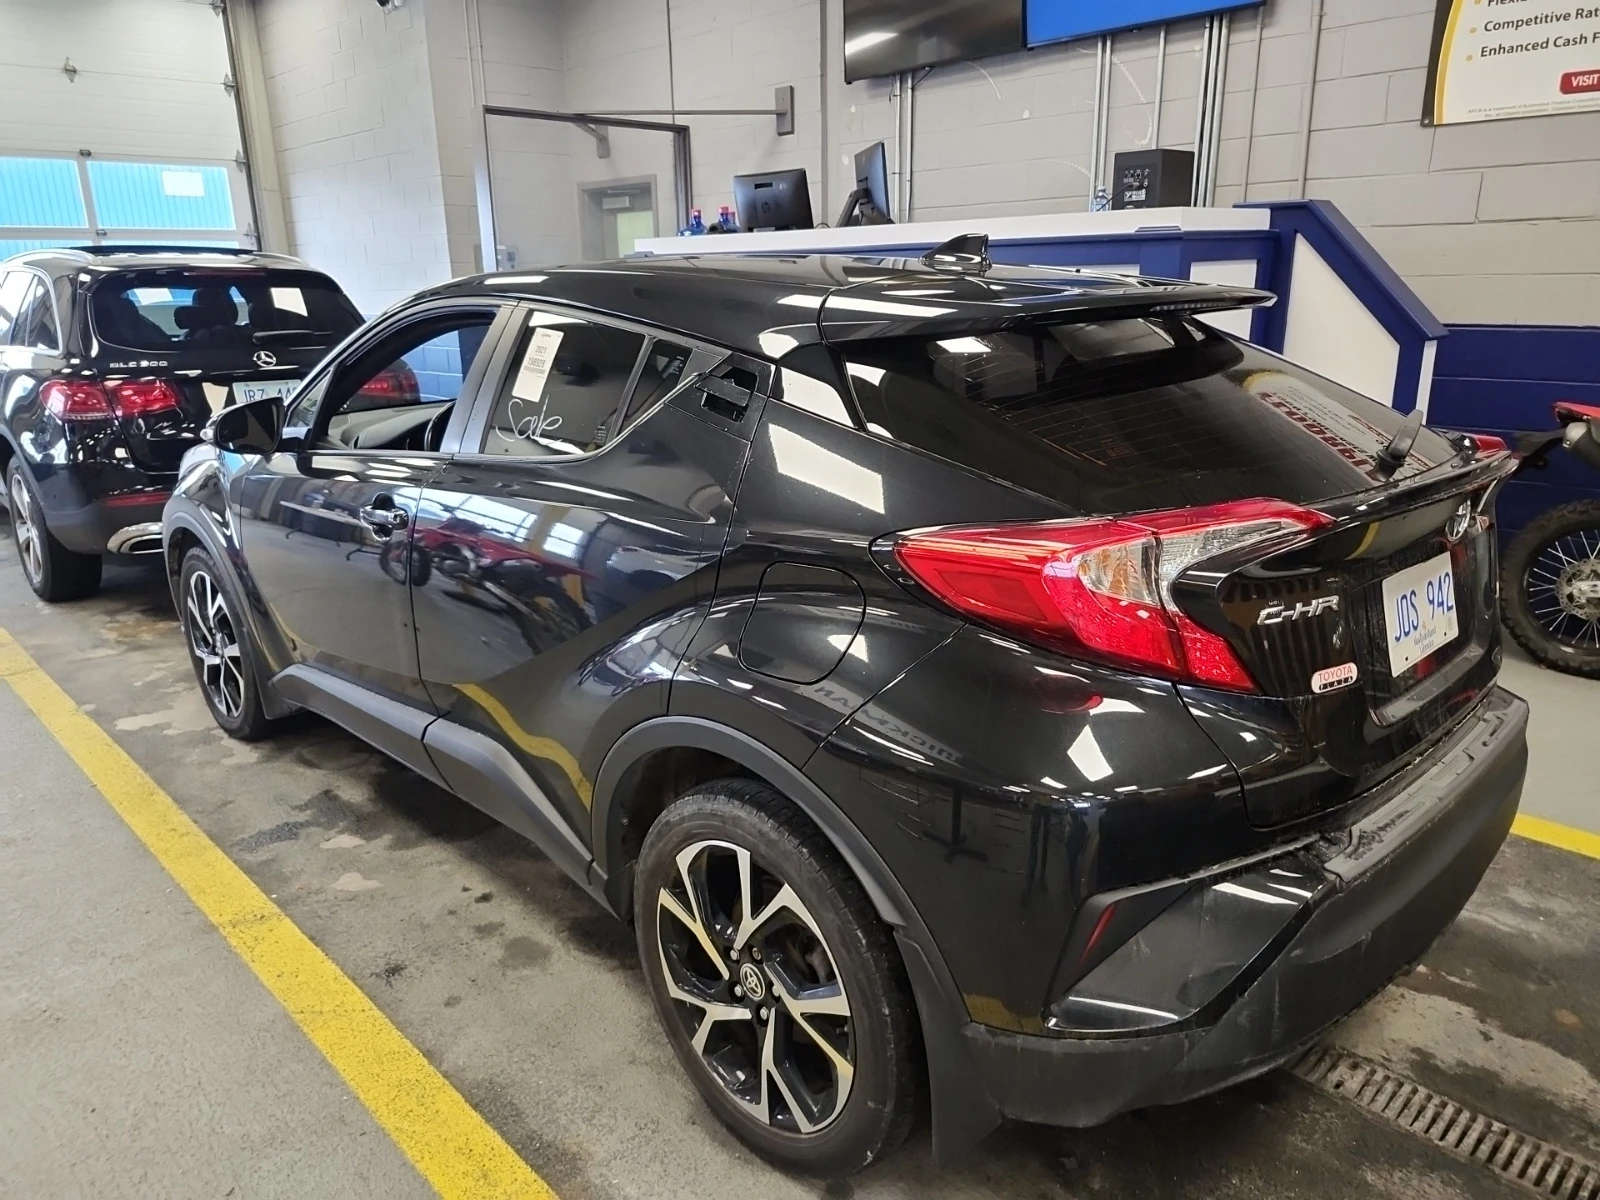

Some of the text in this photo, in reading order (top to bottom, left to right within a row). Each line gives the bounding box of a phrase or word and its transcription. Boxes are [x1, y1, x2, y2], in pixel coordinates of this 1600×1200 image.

[1484, 11, 1571, 32] Competitive
[1480, 37, 1550, 57] Enhanced
[1553, 34, 1588, 48] Cash
[1571, 74, 1600, 87] VISIT
[1427, 571, 1454, 619] 942
[1257, 595, 1339, 625] C-HR
[1318, 666, 1353, 683] TOYOTA
